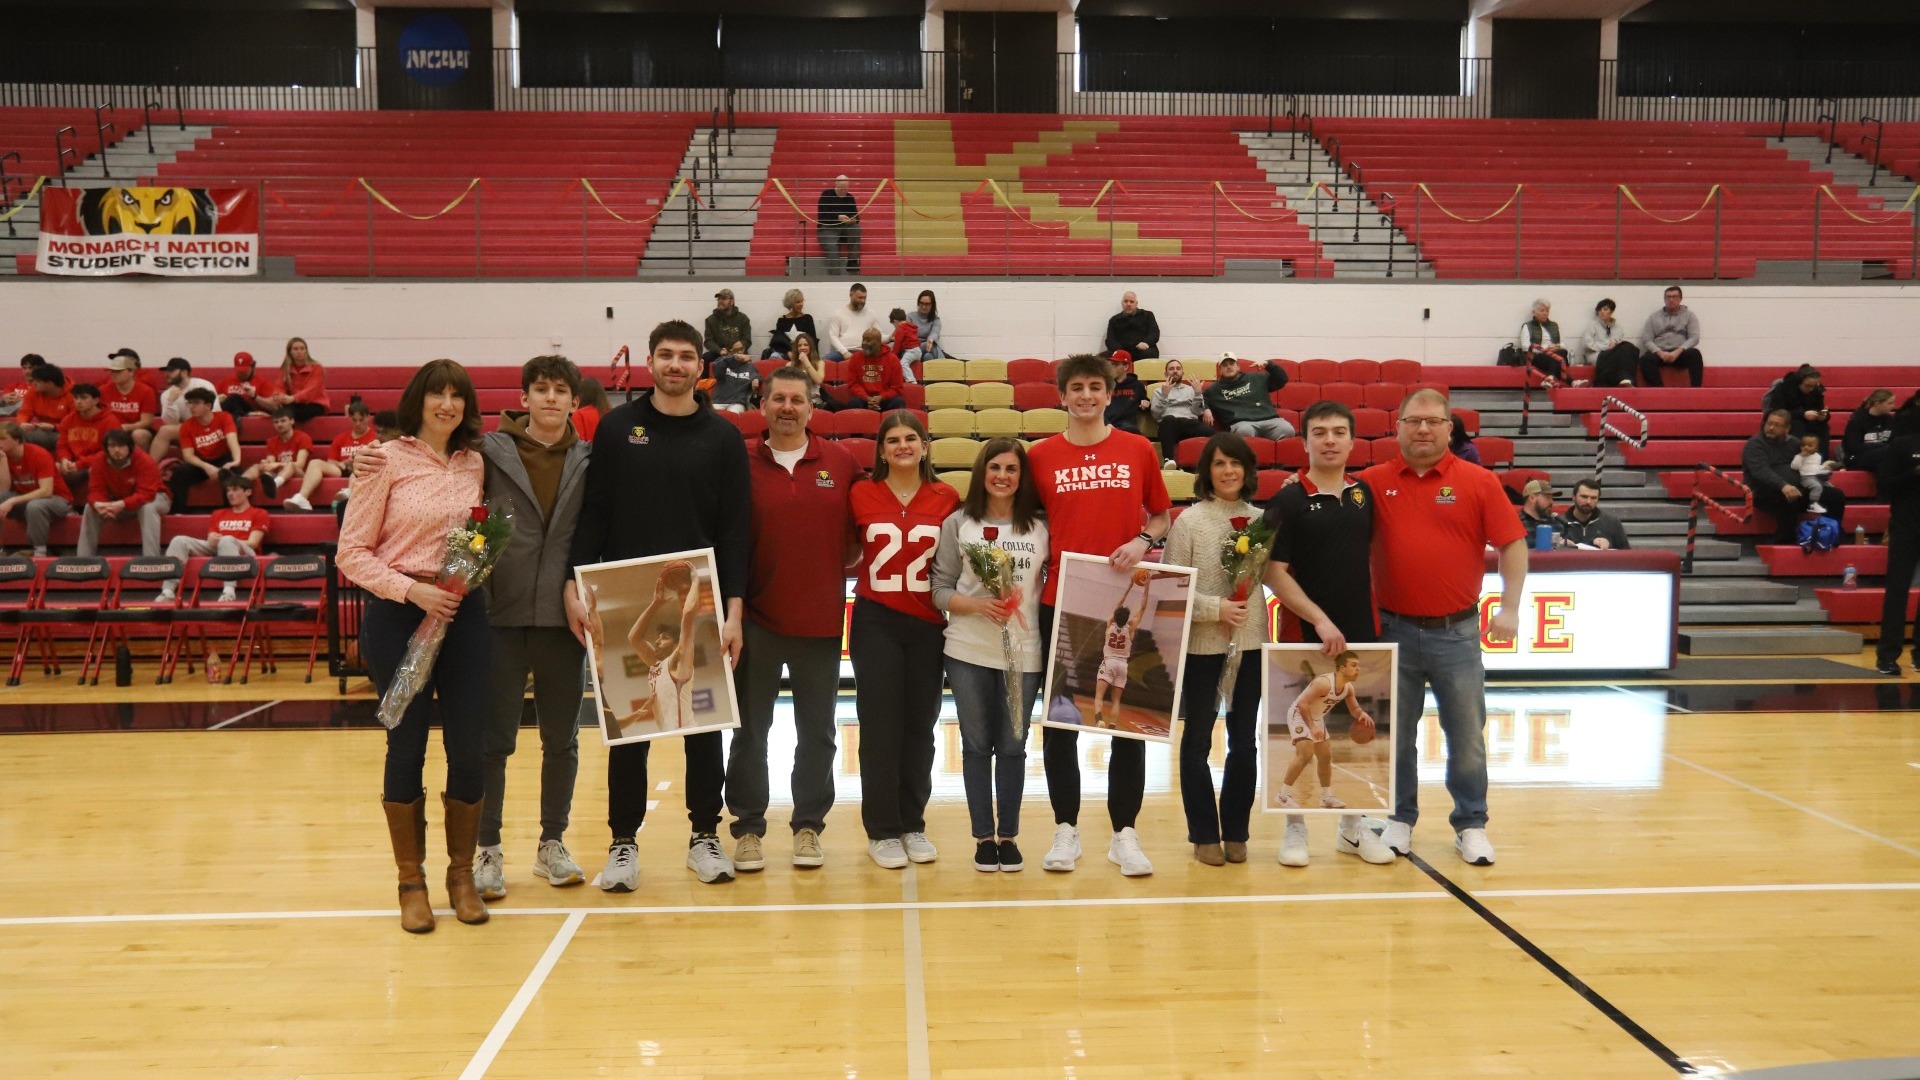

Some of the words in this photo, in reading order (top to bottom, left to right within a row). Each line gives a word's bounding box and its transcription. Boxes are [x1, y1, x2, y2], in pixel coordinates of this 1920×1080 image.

[49, 239, 160, 255] MONARCH
[167, 240, 250, 253] NATION
[47, 253, 146, 269] STUDENT
[153, 255, 250, 268] SECTION
[1055, 463, 1131, 484] KING'S
[1056, 479, 1131, 493] ATHLETICS
[1002, 541, 1036, 554] COLLEGE
[866, 522, 941, 593] 22
[1108, 632, 1126, 650] 22
